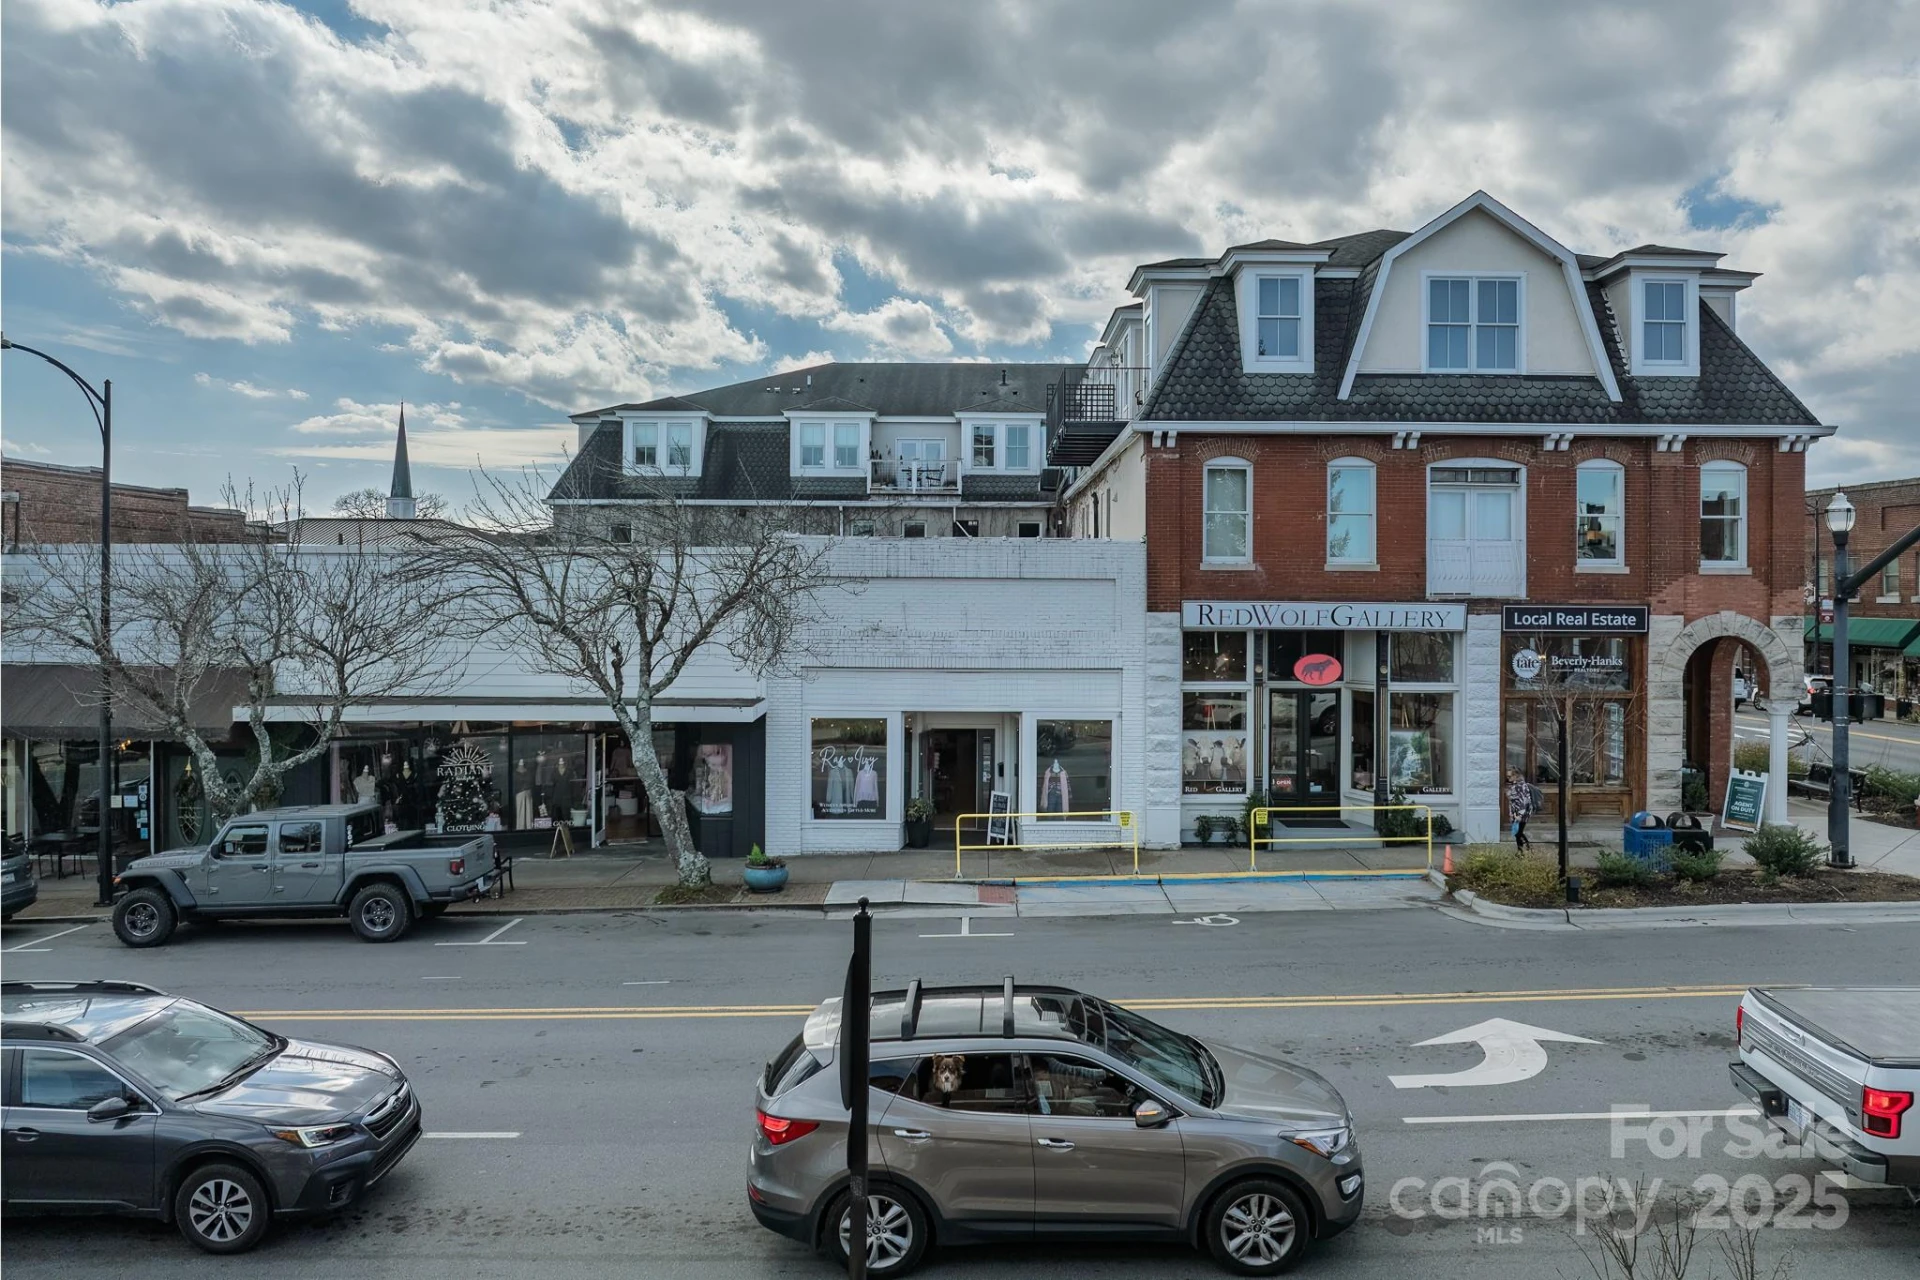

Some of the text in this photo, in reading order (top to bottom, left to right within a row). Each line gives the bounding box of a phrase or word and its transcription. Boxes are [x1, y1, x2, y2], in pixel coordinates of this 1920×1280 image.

[1514, 612, 1637, 626] Local Real Estate
[1516, 657, 1540, 669] tate
[1551, 655, 1623, 669] Beverly-Hanks
[437, 766, 495, 777] RADIANT
[447, 824, 486, 832] CLOTHING
